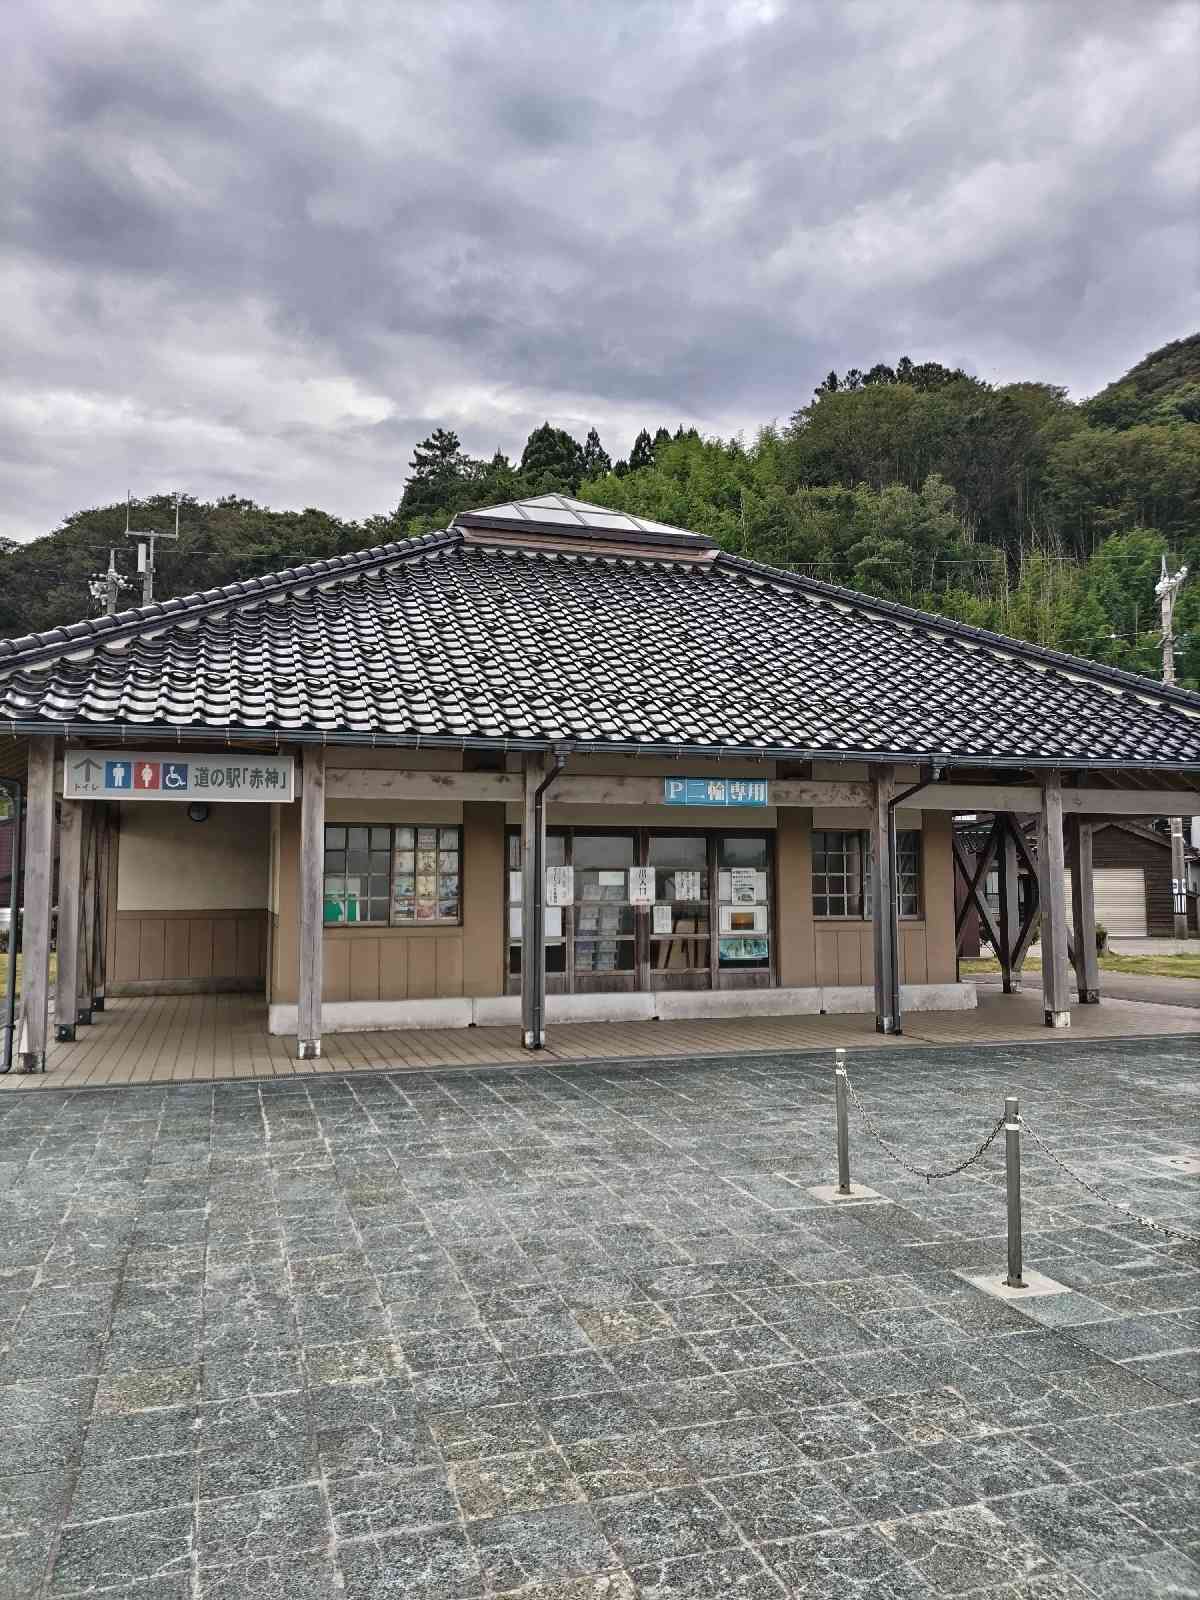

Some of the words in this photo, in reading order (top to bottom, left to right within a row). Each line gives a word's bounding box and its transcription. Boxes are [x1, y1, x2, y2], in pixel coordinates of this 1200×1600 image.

[194, 767, 286, 789] 道の駅「赤神」
[74, 783, 99, 792] トイレ
